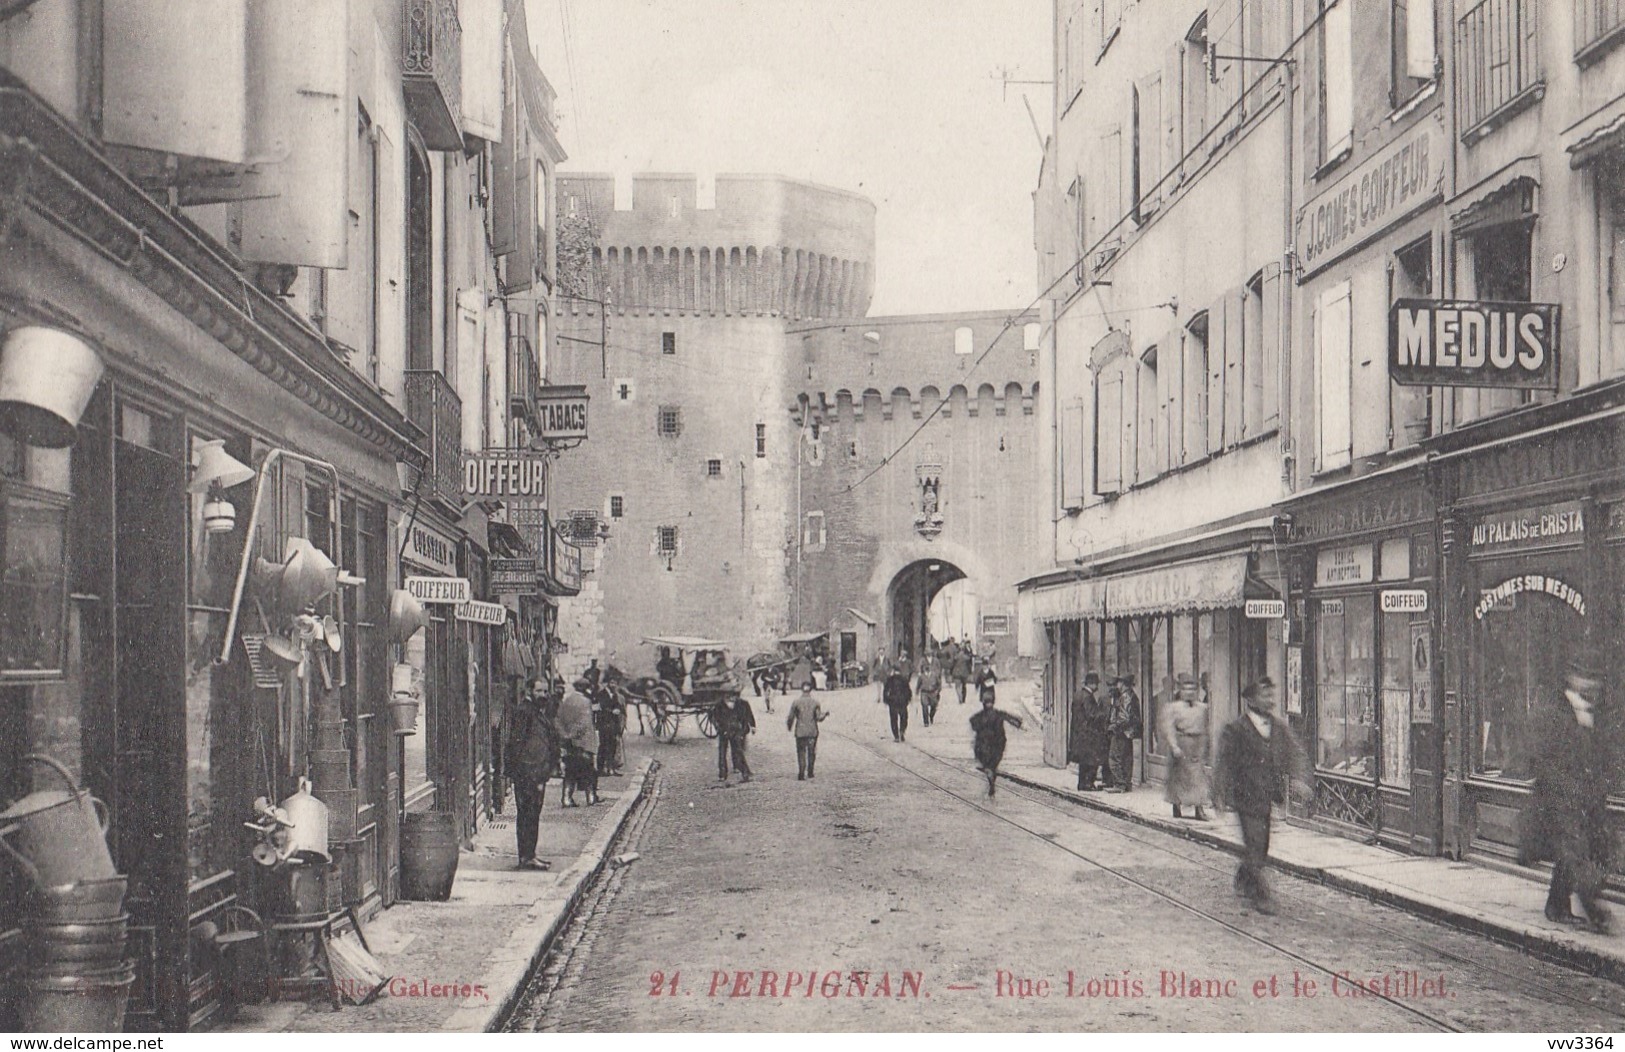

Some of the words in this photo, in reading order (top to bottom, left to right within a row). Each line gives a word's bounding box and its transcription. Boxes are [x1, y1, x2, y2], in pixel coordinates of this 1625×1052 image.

[1360, 132, 1431, 226] COIFFEUR
[1397, 308, 1545, 371] MEDUS
[540, 404, 585, 431] TABACS
[1472, 525, 1486, 545] AU
[1488, 520, 1529, 544] PALAIS
[408, 579, 465, 601] COIFFEUR
[1385, 594, 1425, 609] COIFFEUR
[1475, 577, 1523, 619] COSTUMES
[1524, 575, 1544, 591] SUR
[457, 602, 503, 622] COIFFEUR
[1247, 603, 1284, 615] COIFFEUR
